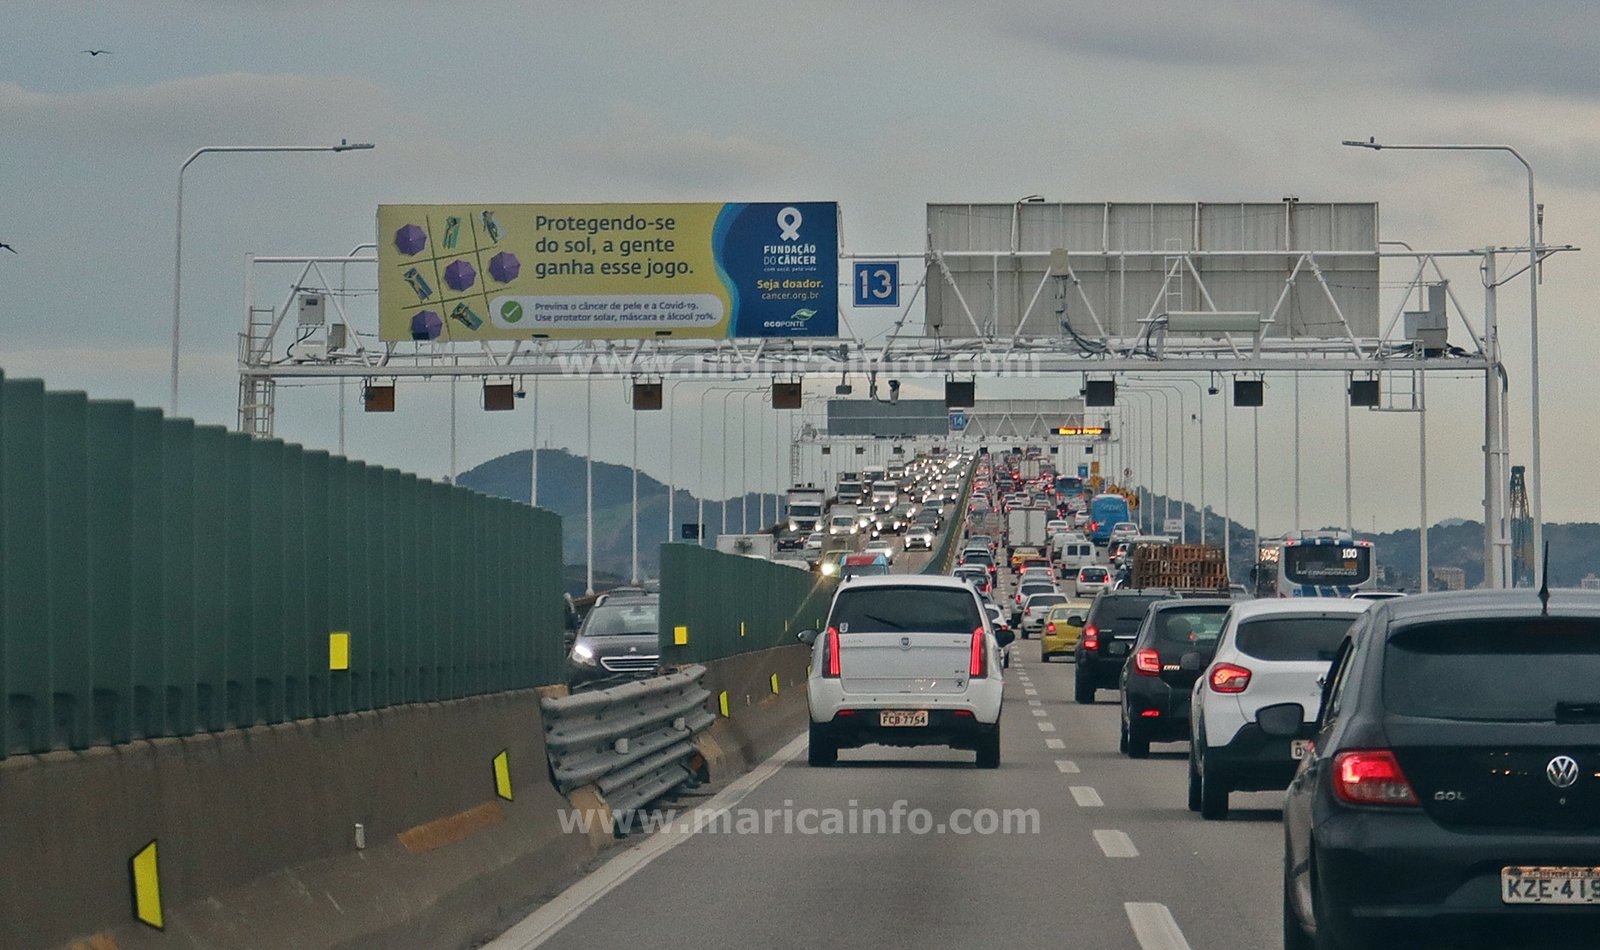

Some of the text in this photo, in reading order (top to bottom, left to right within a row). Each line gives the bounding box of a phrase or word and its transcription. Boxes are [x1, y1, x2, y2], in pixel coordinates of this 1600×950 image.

[535, 215, 676, 234] Protegendo-se
[535, 237, 674, 256] do sol, a gente
[763, 243, 816, 255] FUNDAÇÃO
[763, 254, 816, 265] DO CÂNCER
[535, 259, 693, 279] ganha esse jogo.
[757, 279, 824, 291] Seja doador.
[859, 270, 893, 299] 13
[761, 291, 820, 301] cancer.org.br
[534, 302, 569, 311] Previna
[578, 301, 608, 311] câncer
[610, 301, 622, 311] de
[623, 301, 642, 312] pele
[659, 301, 699, 311] Covid-19.
[534, 313, 552, 322] Use
[553, 313, 592, 323] protetor
[593, 313, 618, 322] solar,
[619, 312, 658, 321] máscara
[666, 311, 694, 321] álcool
[694, 311, 717, 322] 70%.
[1342, 548, 1358, 559] 100
[1434, 791, 1465, 801] GOL
